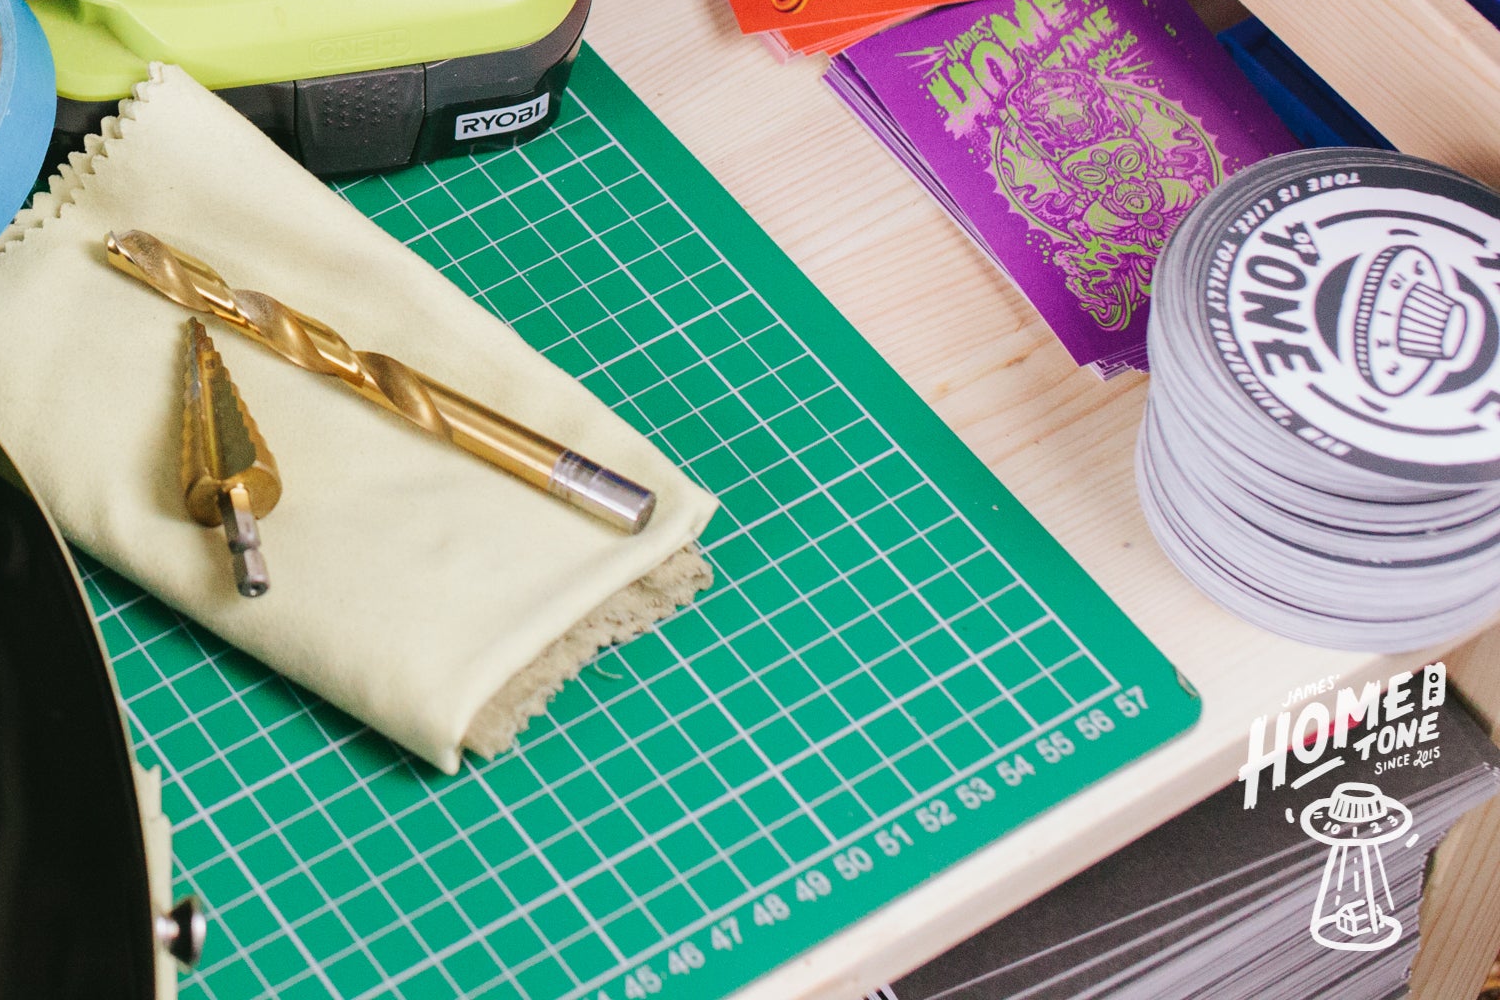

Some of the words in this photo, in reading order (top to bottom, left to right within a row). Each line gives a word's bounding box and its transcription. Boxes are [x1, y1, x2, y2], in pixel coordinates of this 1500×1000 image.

[461, 101, 541, 134] RYOBI
[1277, 184, 1300, 203] IS
[1306, 172, 1361, 192] TONE
[1292, 231, 1316, 255] OF
[1207, 240, 1237, 313] TOTALLY
[1240, 222, 1324, 377] TONE
[624, 965, 663, 999] 45
[667, 941, 706, 975] 46
[710, 916, 743, 951] 47
[753, 893, 791, 926] 48
[795, 869, 832, 902] 49
[833, 847, 874, 880] 50
[874, 822, 914, 857] 51
[914, 799, 957, 833] 52
[955, 777, 996, 810] 53
[996, 754, 1036, 786] 54
[1036, 730, 1076, 763] 55
[1074, 709, 1115, 741] 56
[1113, 685, 1149, 718] 57
